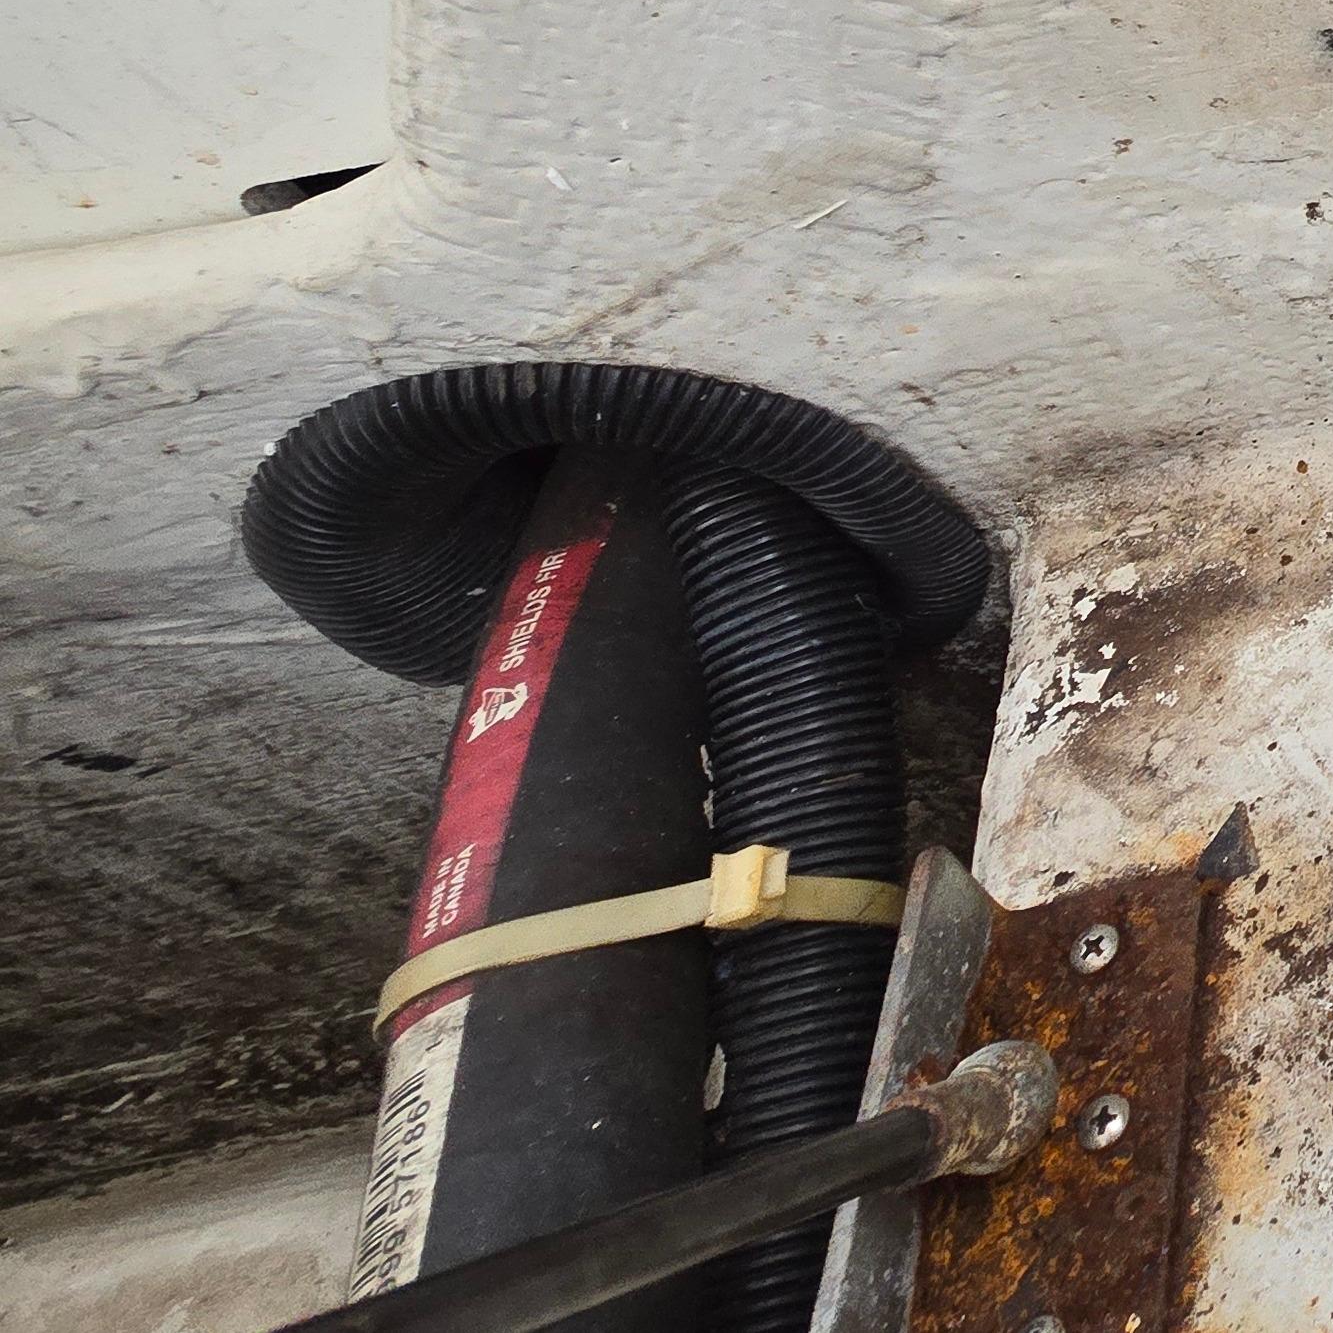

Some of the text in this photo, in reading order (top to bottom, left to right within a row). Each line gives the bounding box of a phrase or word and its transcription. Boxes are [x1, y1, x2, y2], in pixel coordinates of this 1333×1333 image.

[499, 546, 570, 672] SHIELDS FIR
[422, 857, 454, 939] MADE IN
[441, 843, 476, 926] CANADA
[388, 1100, 431, 1216] 57186
